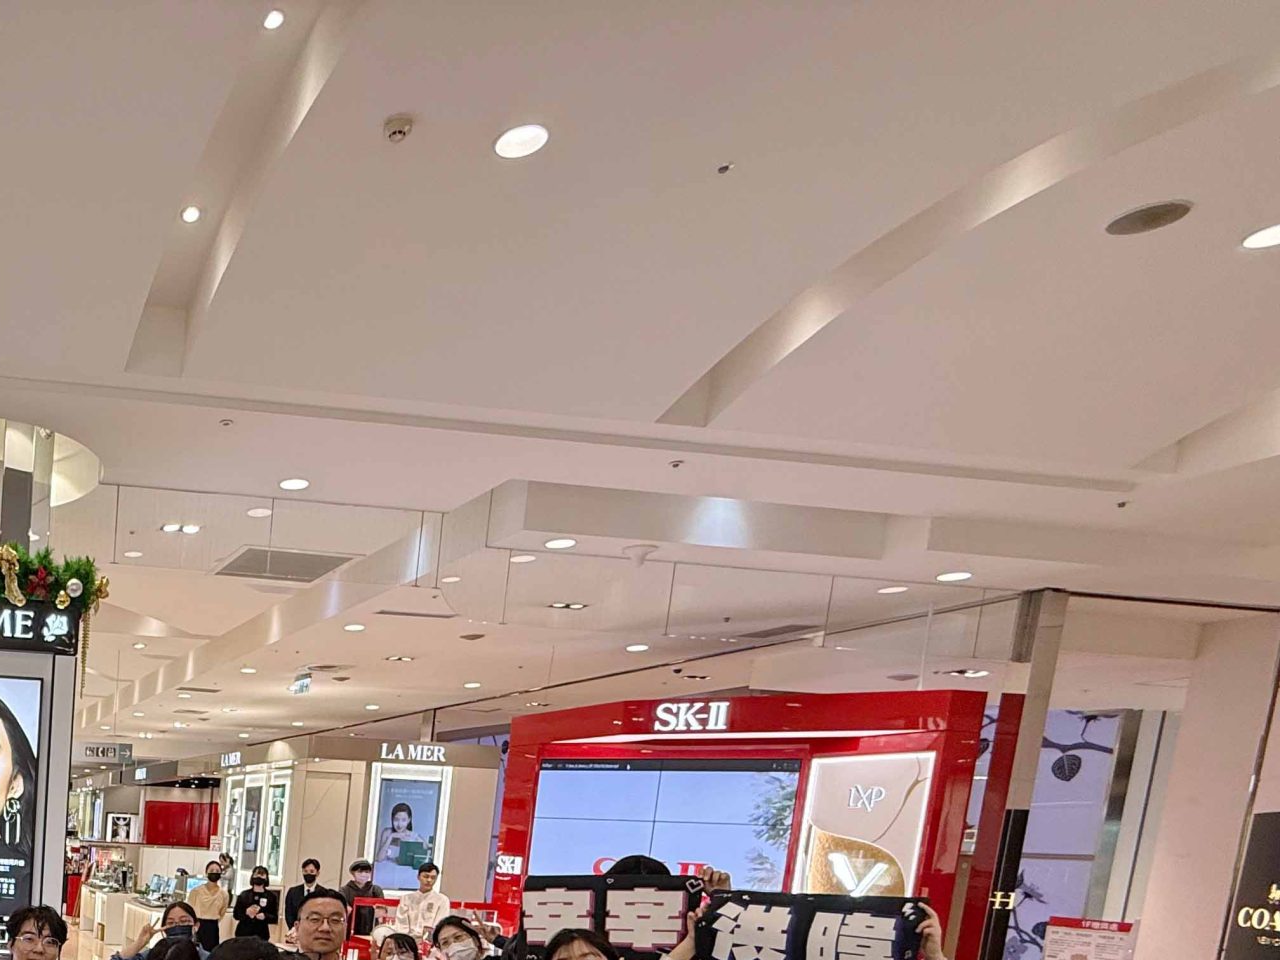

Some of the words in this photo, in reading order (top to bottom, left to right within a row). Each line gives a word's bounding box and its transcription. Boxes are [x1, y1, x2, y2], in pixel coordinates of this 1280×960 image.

[654, 702, 731, 732] SK-II
[380, 743, 405, 760] LA
[407, 744, 446, 762] MER
